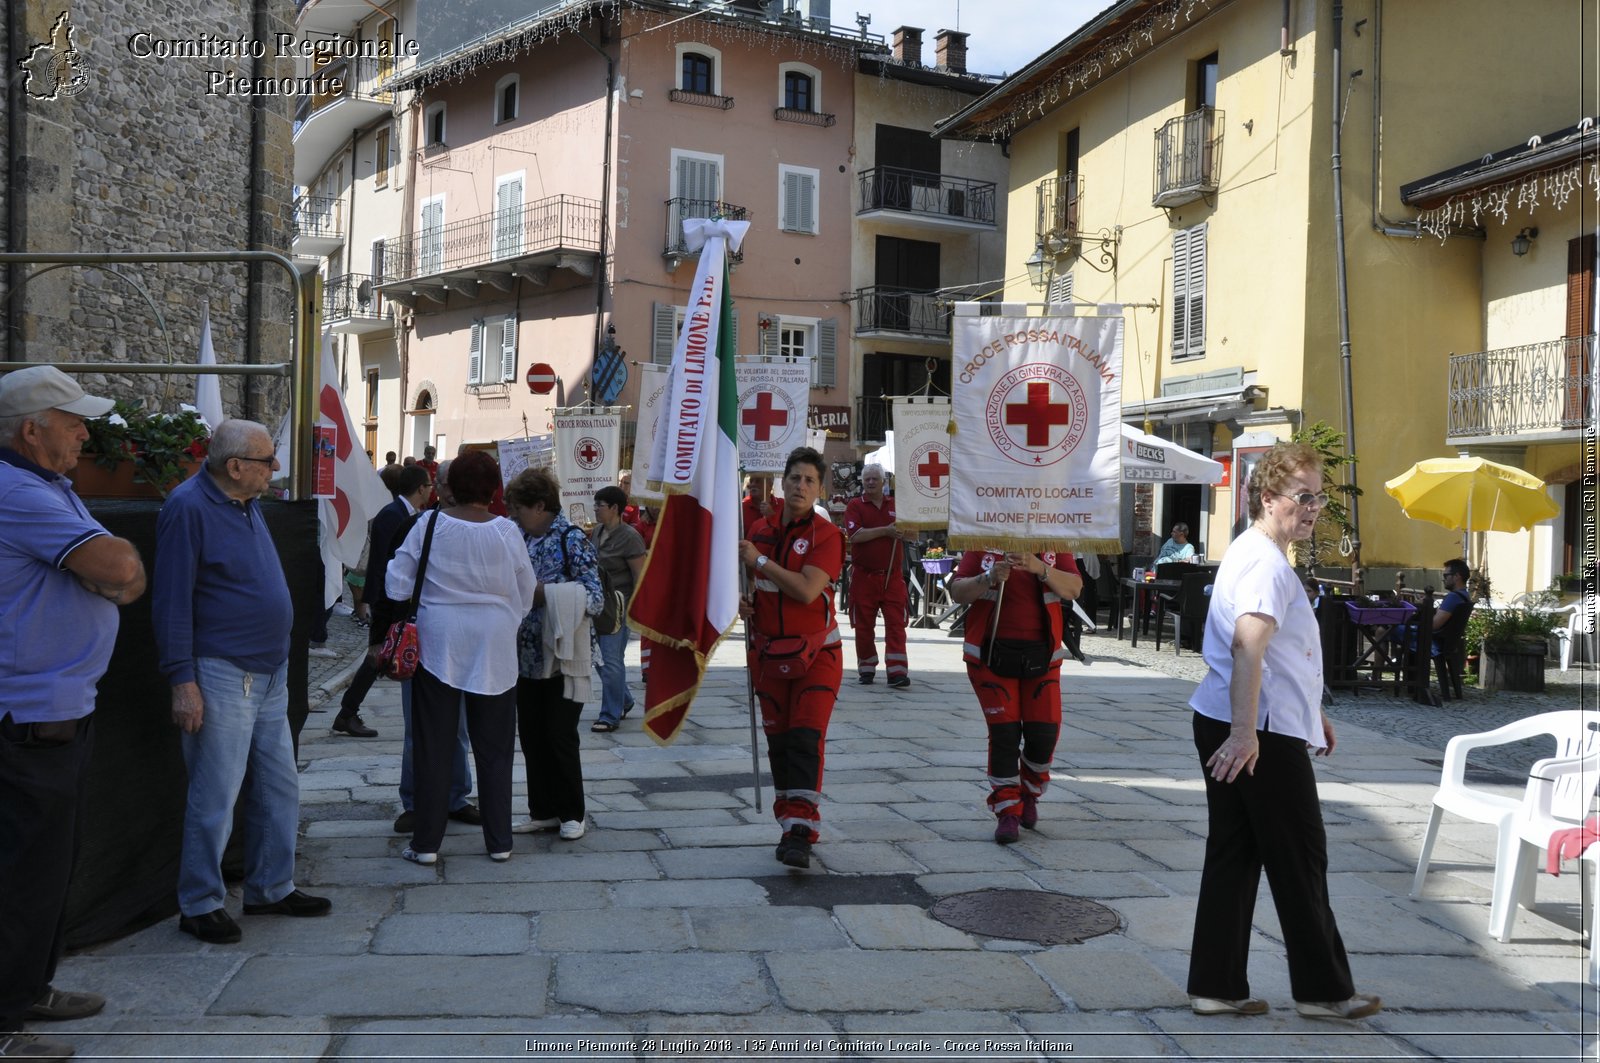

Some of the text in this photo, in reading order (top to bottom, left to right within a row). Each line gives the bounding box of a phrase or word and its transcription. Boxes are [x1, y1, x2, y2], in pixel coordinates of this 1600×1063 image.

[684, 311, 710, 375] LIMONE
[959, 329, 1116, 385] CROCE ROSSA ITALIANA
[685, 379, 704, 394] DI
[988, 366, 1085, 452] CONVENZIONE DI GINEVRA 22 AGOSTO 1864
[557, 419, 575, 429] CROCE
[576, 419, 592, 429] ROSSA
[674, 398, 701, 481] COMITATO
[740, 451, 783, 459] ELEGAZIONE
[1138, 446, 1165, 462] BECK'S
[976, 487, 1094, 498] COMITATO LOCALE
[1030, 501, 1040, 510] DI
[976, 513, 1092, 524] LIMONE PIEMONTE
